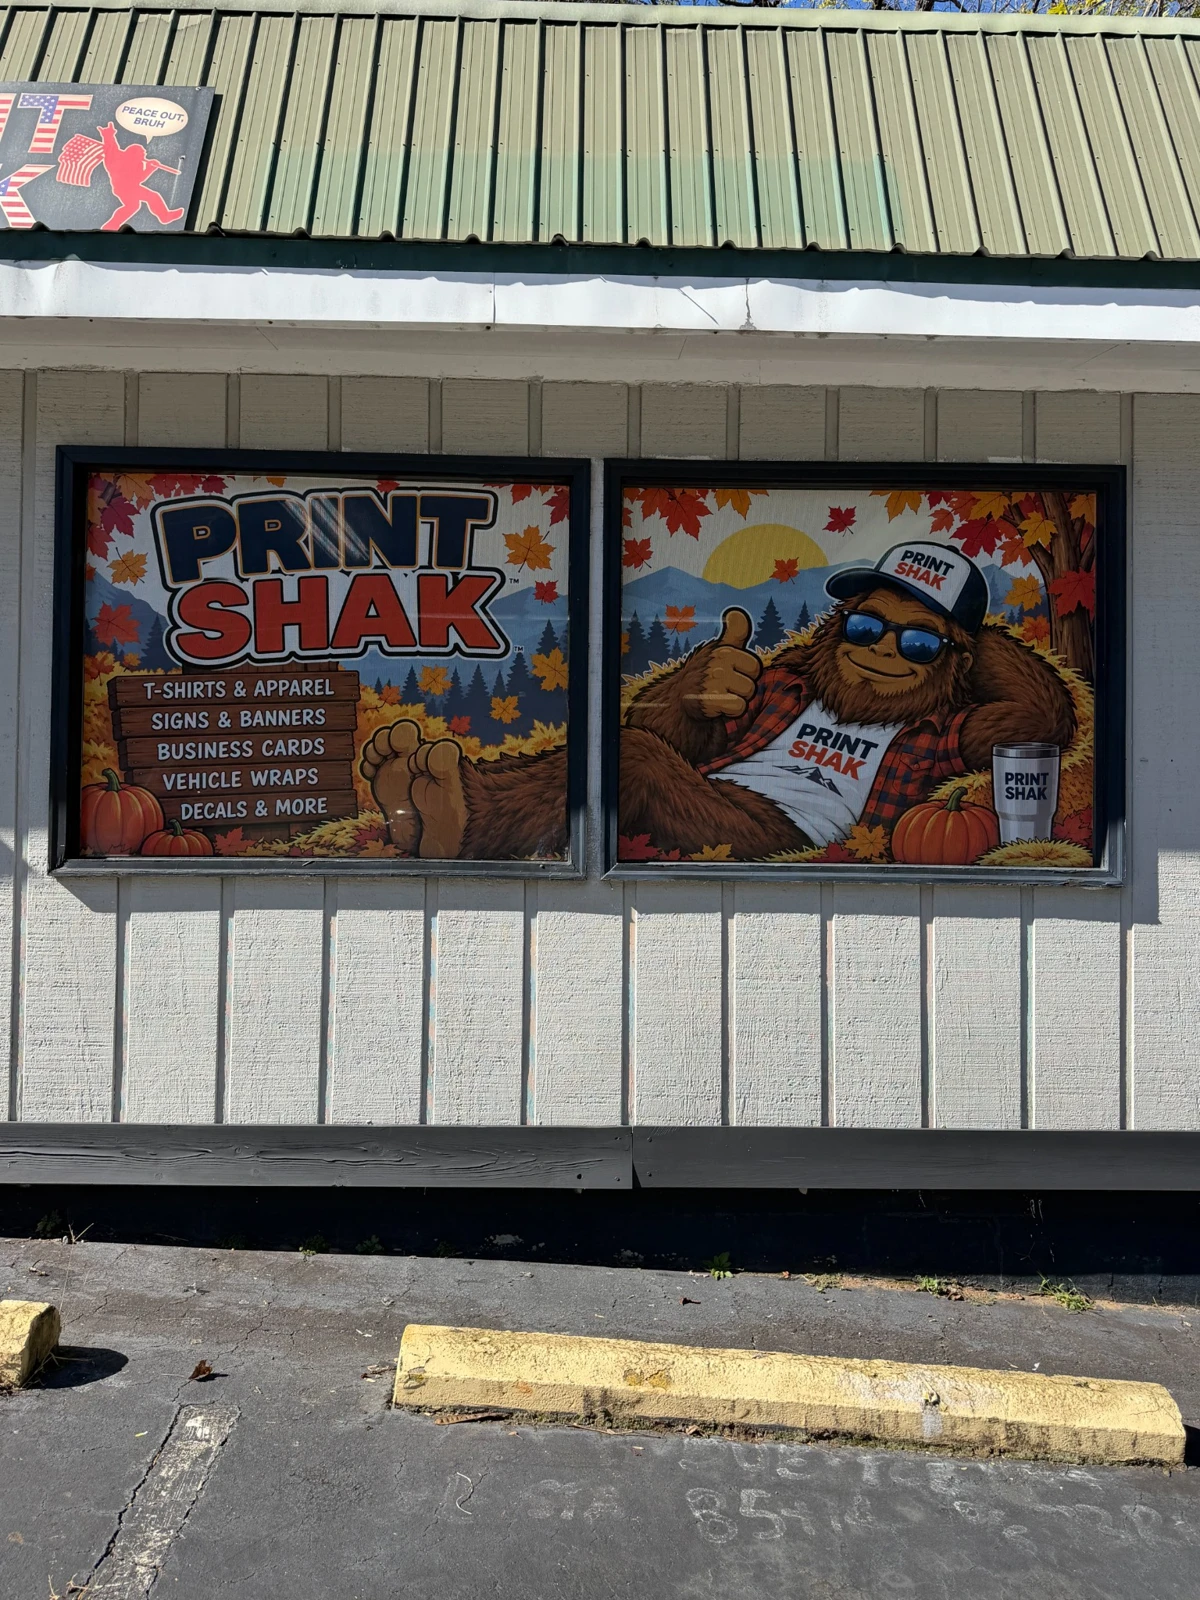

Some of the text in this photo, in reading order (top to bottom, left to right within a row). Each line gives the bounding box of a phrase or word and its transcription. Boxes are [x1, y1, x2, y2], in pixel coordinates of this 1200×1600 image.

[0, 93, 93, 153] T
[122, 106, 158, 118] PEACE
[133, 117, 165, 128] BRUH
[159, 493, 491, 586] PRINT
[901, 550, 955, 576] PRINT
[894, 562, 947, 591] SHAK
[175, 572, 501, 661] SHAK
[144, 678, 335, 699] T-SHIRTS & APPAREL
[151, 708, 326, 730] SIGNS & BANNERS
[157, 737, 325, 760] BUSINESS CARDS
[796, 723, 879, 759] PRINT
[788, 740, 867, 780] SHAK
[162, 767, 319, 791] VEHICLE WRAPS
[1005, 772, 1049, 785] PRINT
[1005, 786, 1047, 800] SHAK
[181, 797, 328, 821] DECALS & MORE
